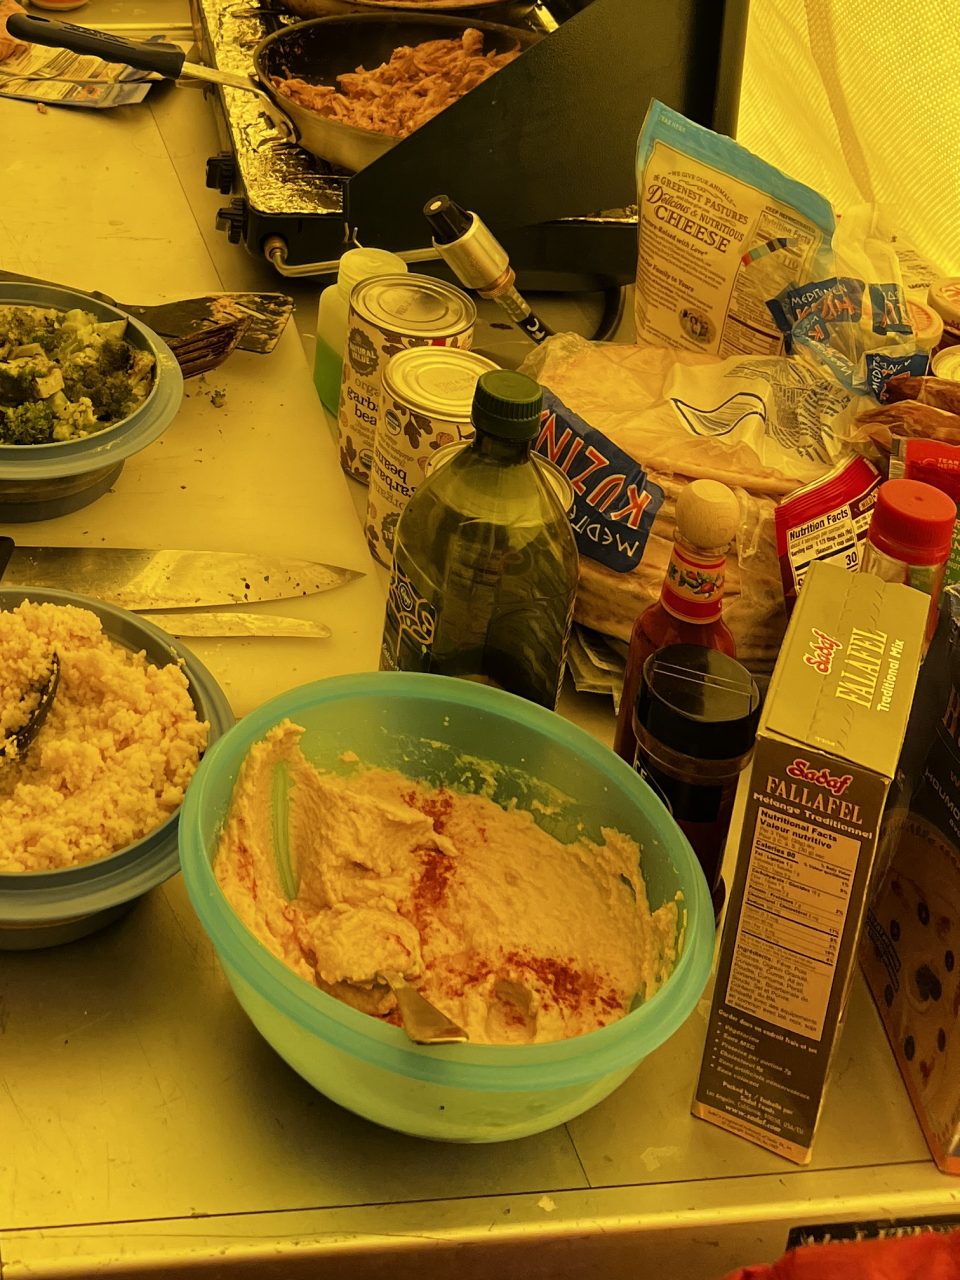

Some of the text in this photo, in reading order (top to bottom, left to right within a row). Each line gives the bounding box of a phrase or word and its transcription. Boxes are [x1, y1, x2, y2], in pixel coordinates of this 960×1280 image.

[646, 184, 745, 242] Delicious & NUTRITIOUS
[660, 176, 704, 202] GREENEST
[704, 194, 749, 225] PASTURES
[654, 205, 731, 253] CHEESE
[527, 318, 546, 340] FC
[350, 342, 377, 359] NATURAL
[352, 351, 371, 365] VALUE
[347, 387, 378, 412] garb
[355, 377, 381, 397] orga
[354, 405, 377, 426] bea
[536, 410, 652, 529] KUZIN
[789, 517, 825, 540] Nutrition
[826, 507, 848, 525] Facts
[845, 551, 858, 566] 30
[803, 627, 843, 675] Sadaf
[835, 627, 888, 710] FALAFEL
[877, 639, 905, 712] Traditional Mix
[786, 759, 853, 796] Sadaf
[753, 792, 873, 839] Mélange Traditionnel
[766, 775, 863, 825] FALLAFEL
[759, 818, 832, 849] Valeur nutritive
[760, 809, 837, 842] Nutritional Facts
[755, 839, 784, 855] Calories
